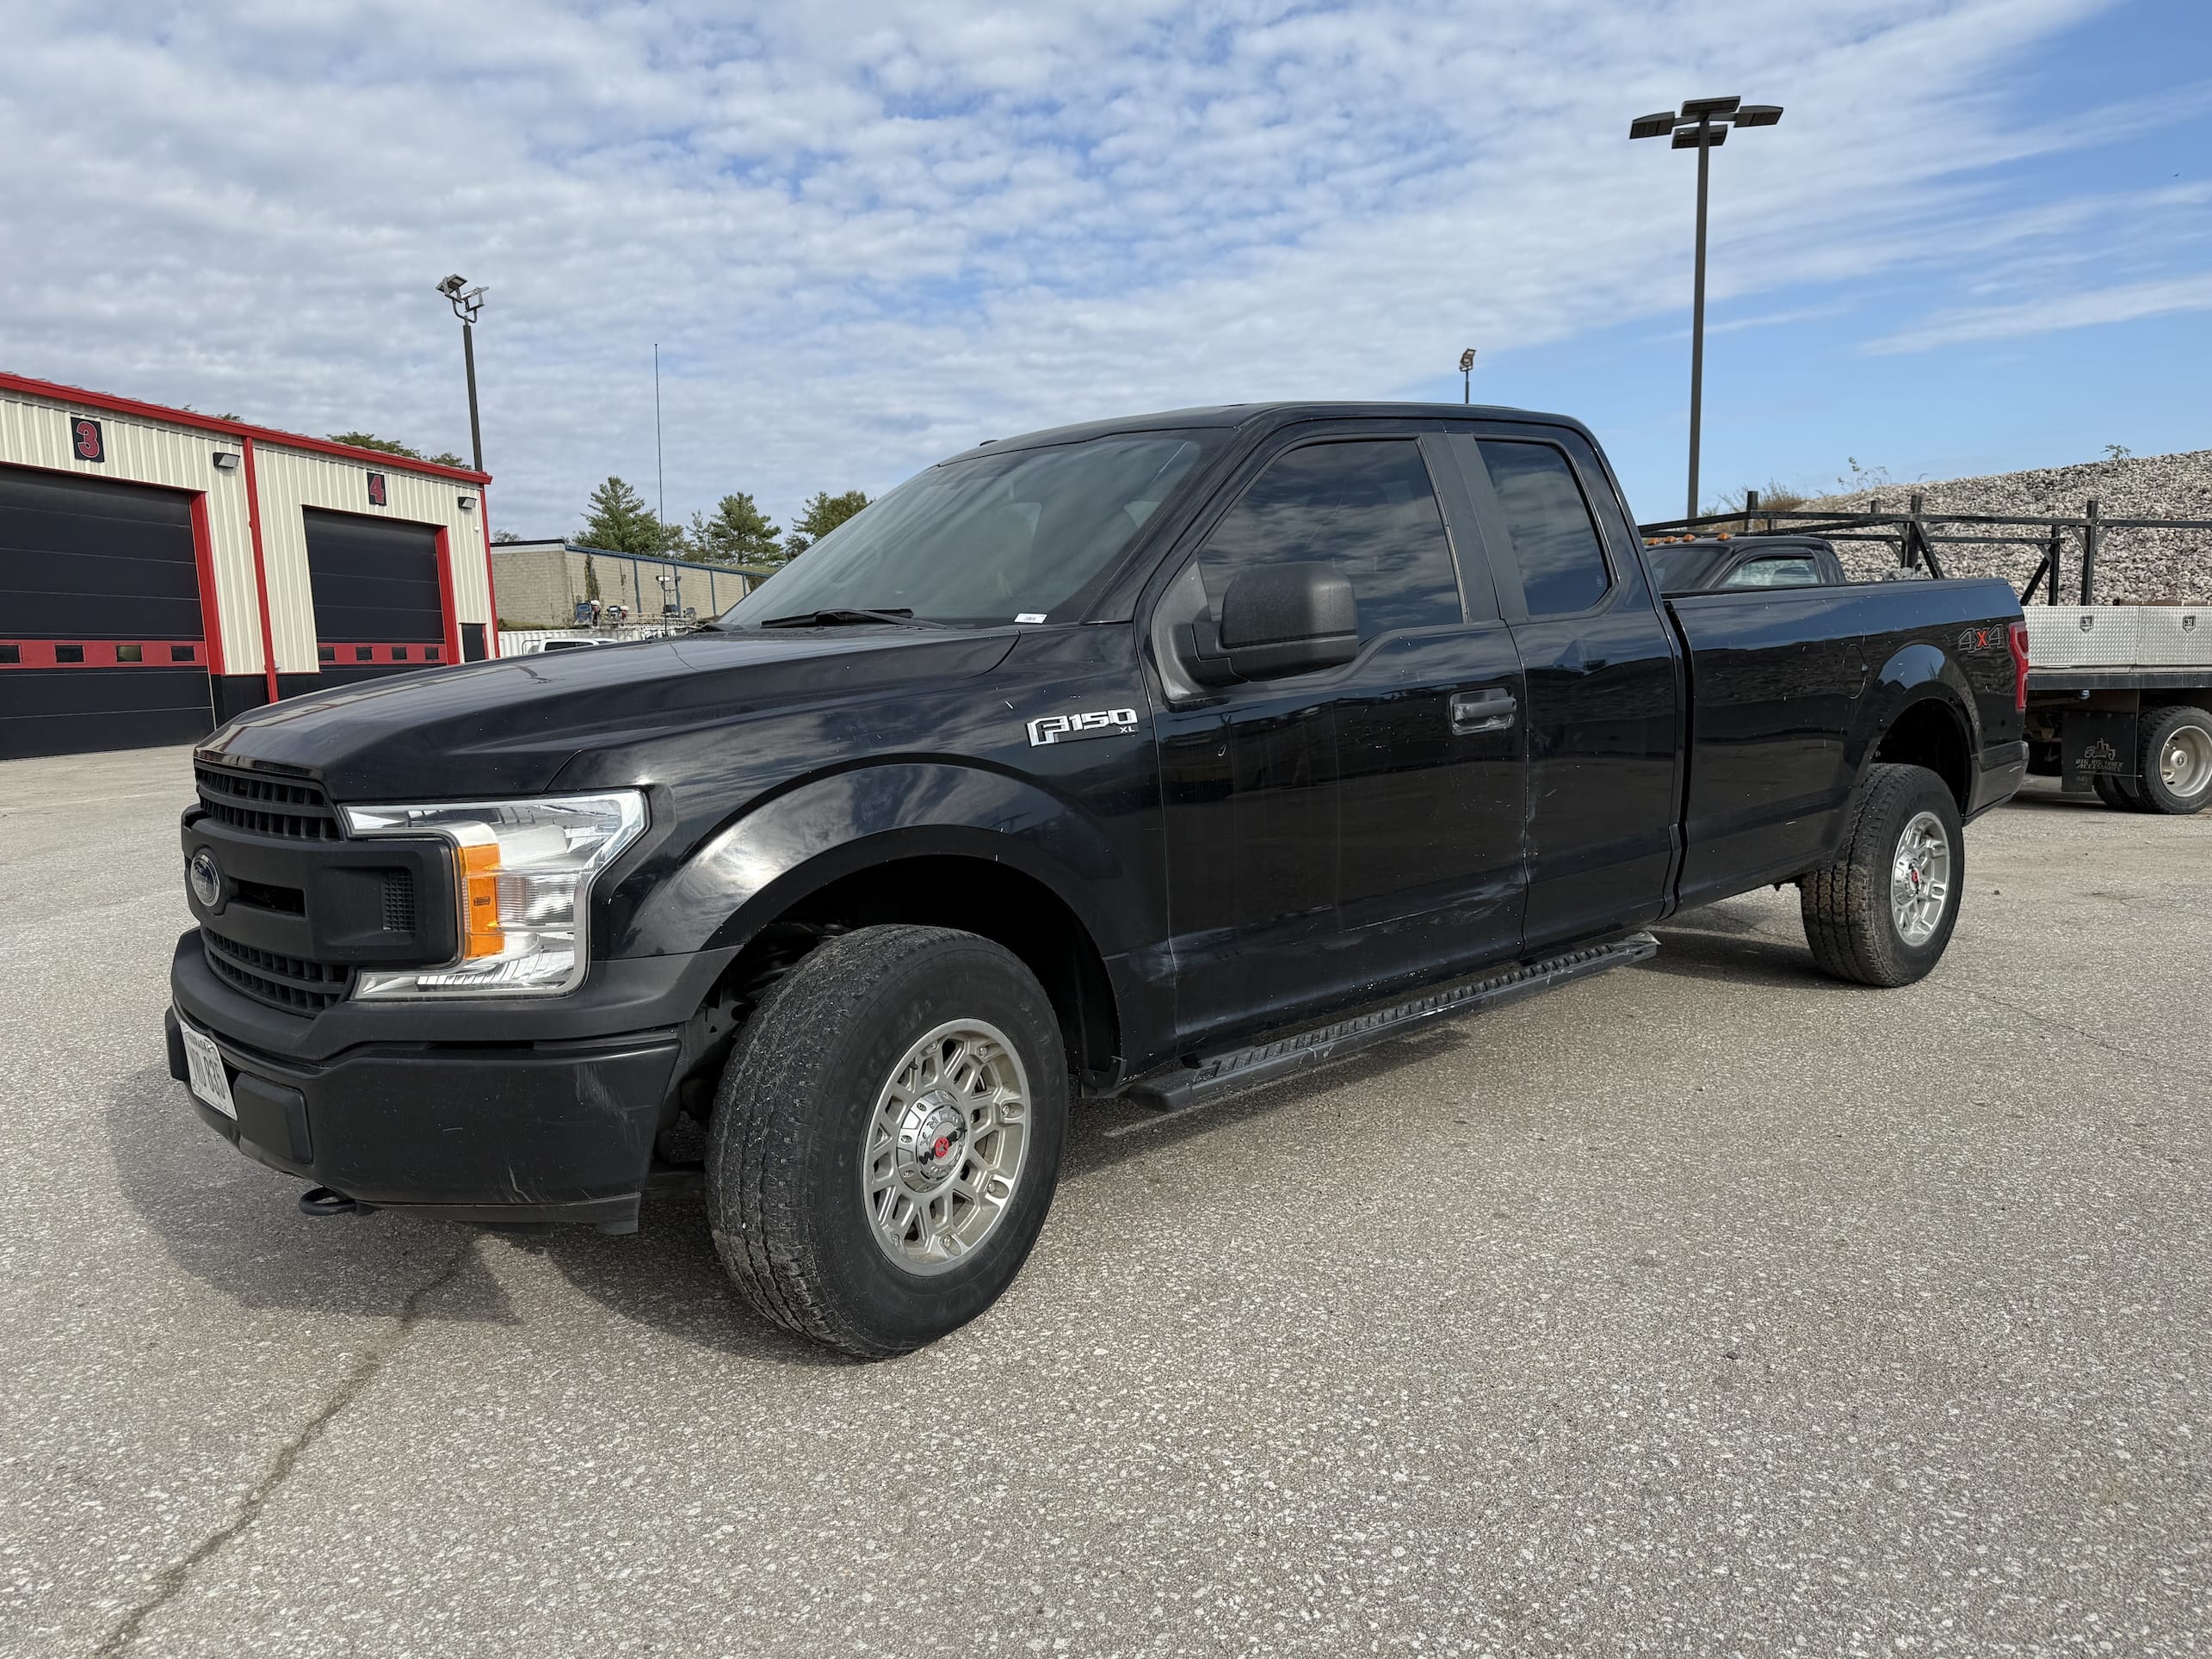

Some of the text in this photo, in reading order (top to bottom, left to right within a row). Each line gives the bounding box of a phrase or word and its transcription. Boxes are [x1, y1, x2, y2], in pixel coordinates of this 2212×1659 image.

[77, 421, 100, 458] 3
[369, 475, 385, 503] 4
[203, 1056, 226, 1100] 835
